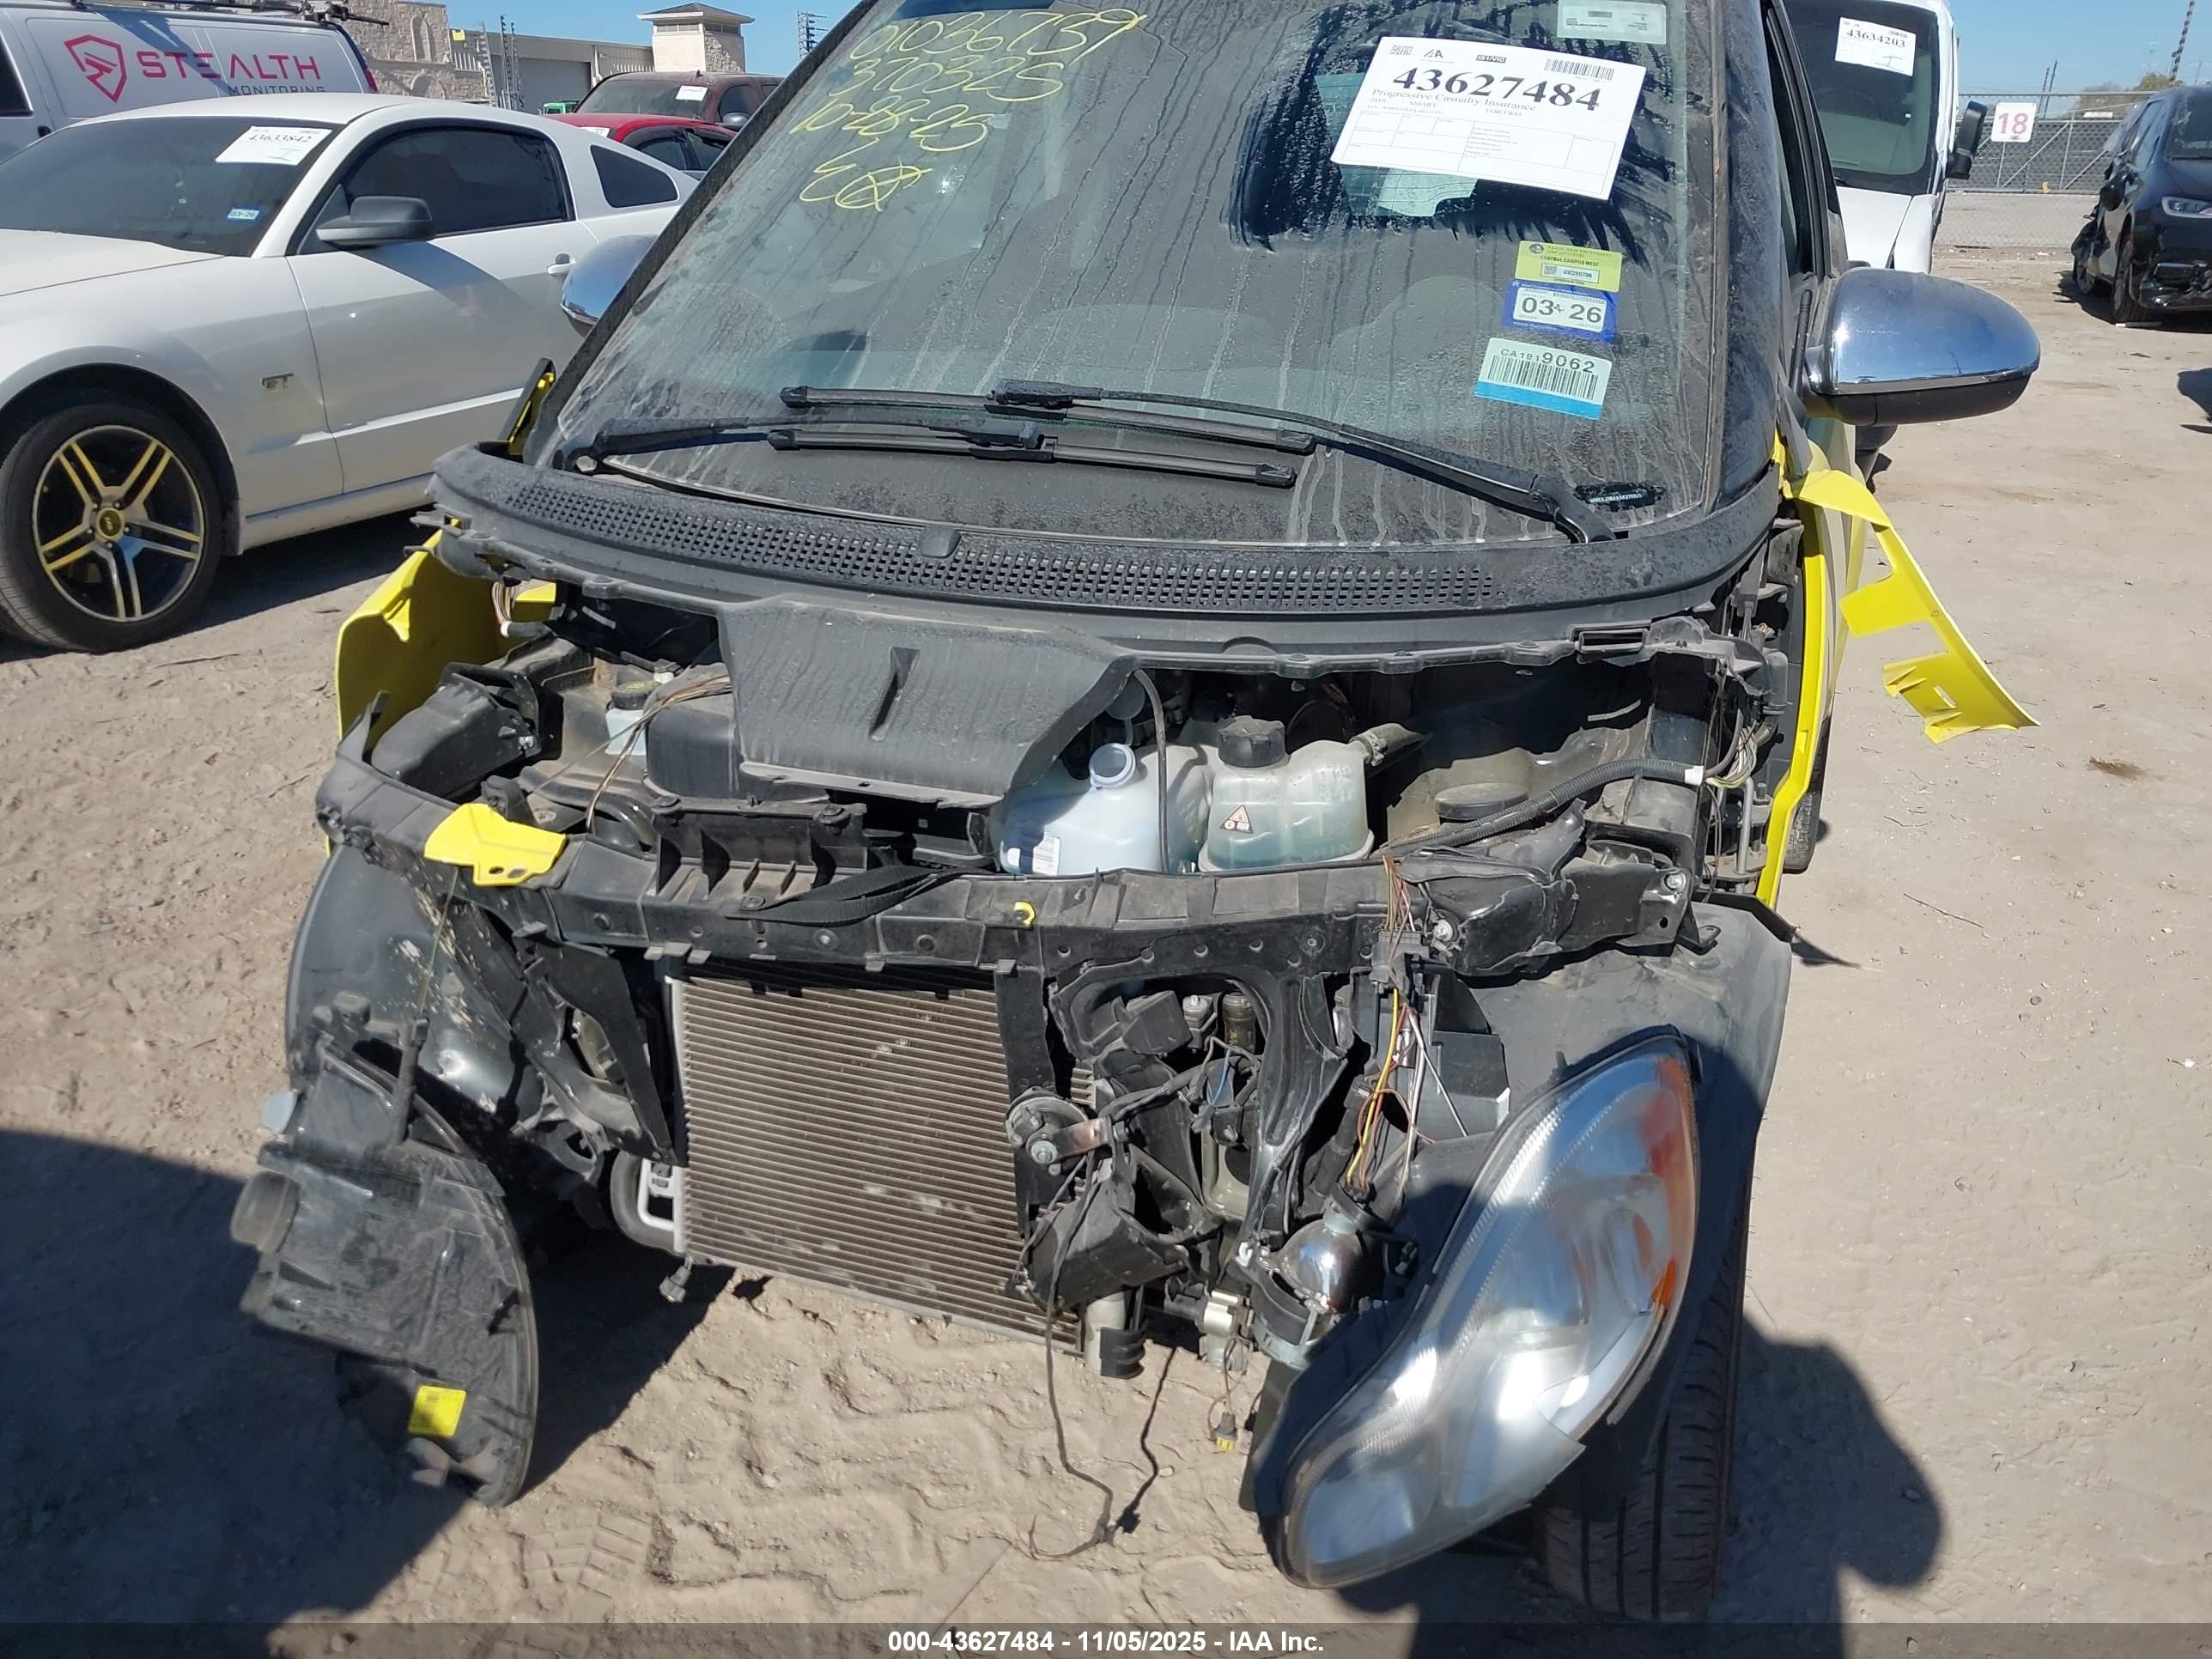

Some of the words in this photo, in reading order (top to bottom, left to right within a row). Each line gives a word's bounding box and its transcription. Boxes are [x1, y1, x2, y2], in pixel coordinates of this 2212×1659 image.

[1847, 28, 1905, 48] 43634203
[137, 51, 322, 80] STEALTH
[1372, 89, 1433, 100] Progressive
[1435, 94, 1481, 106] Casualty
[1485, 99, 1536, 111] Insurance
[1393, 67, 1601, 111] 43627484
[1998, 112, 2028, 135] 18
